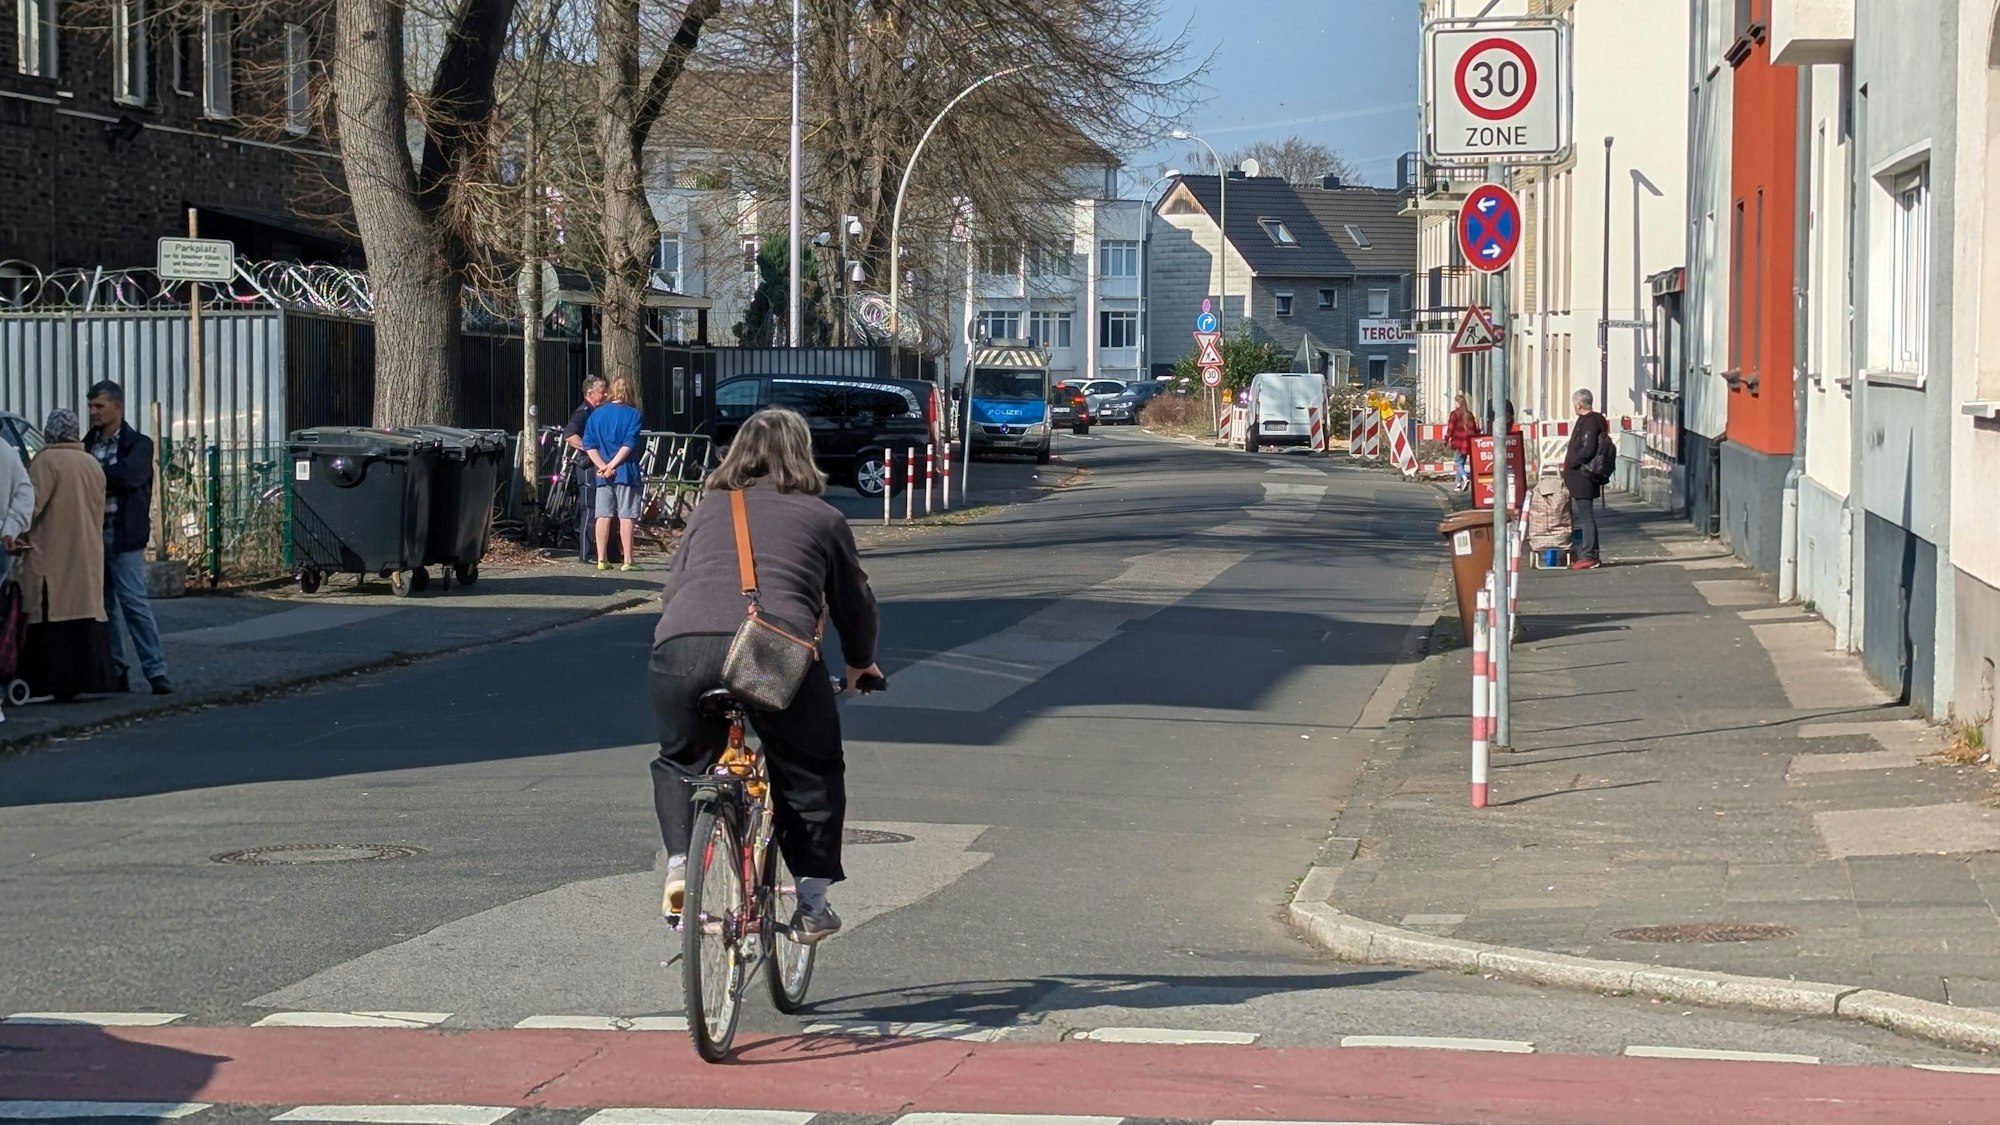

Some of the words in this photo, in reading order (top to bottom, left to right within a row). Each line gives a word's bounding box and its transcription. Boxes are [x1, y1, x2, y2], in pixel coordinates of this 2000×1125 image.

[1472, 60, 1519, 98] 30
[1465, 126, 1528, 147] ZONE
[175, 243, 217, 254] Parkplatz
[1206, 370, 1216, 379] 30
